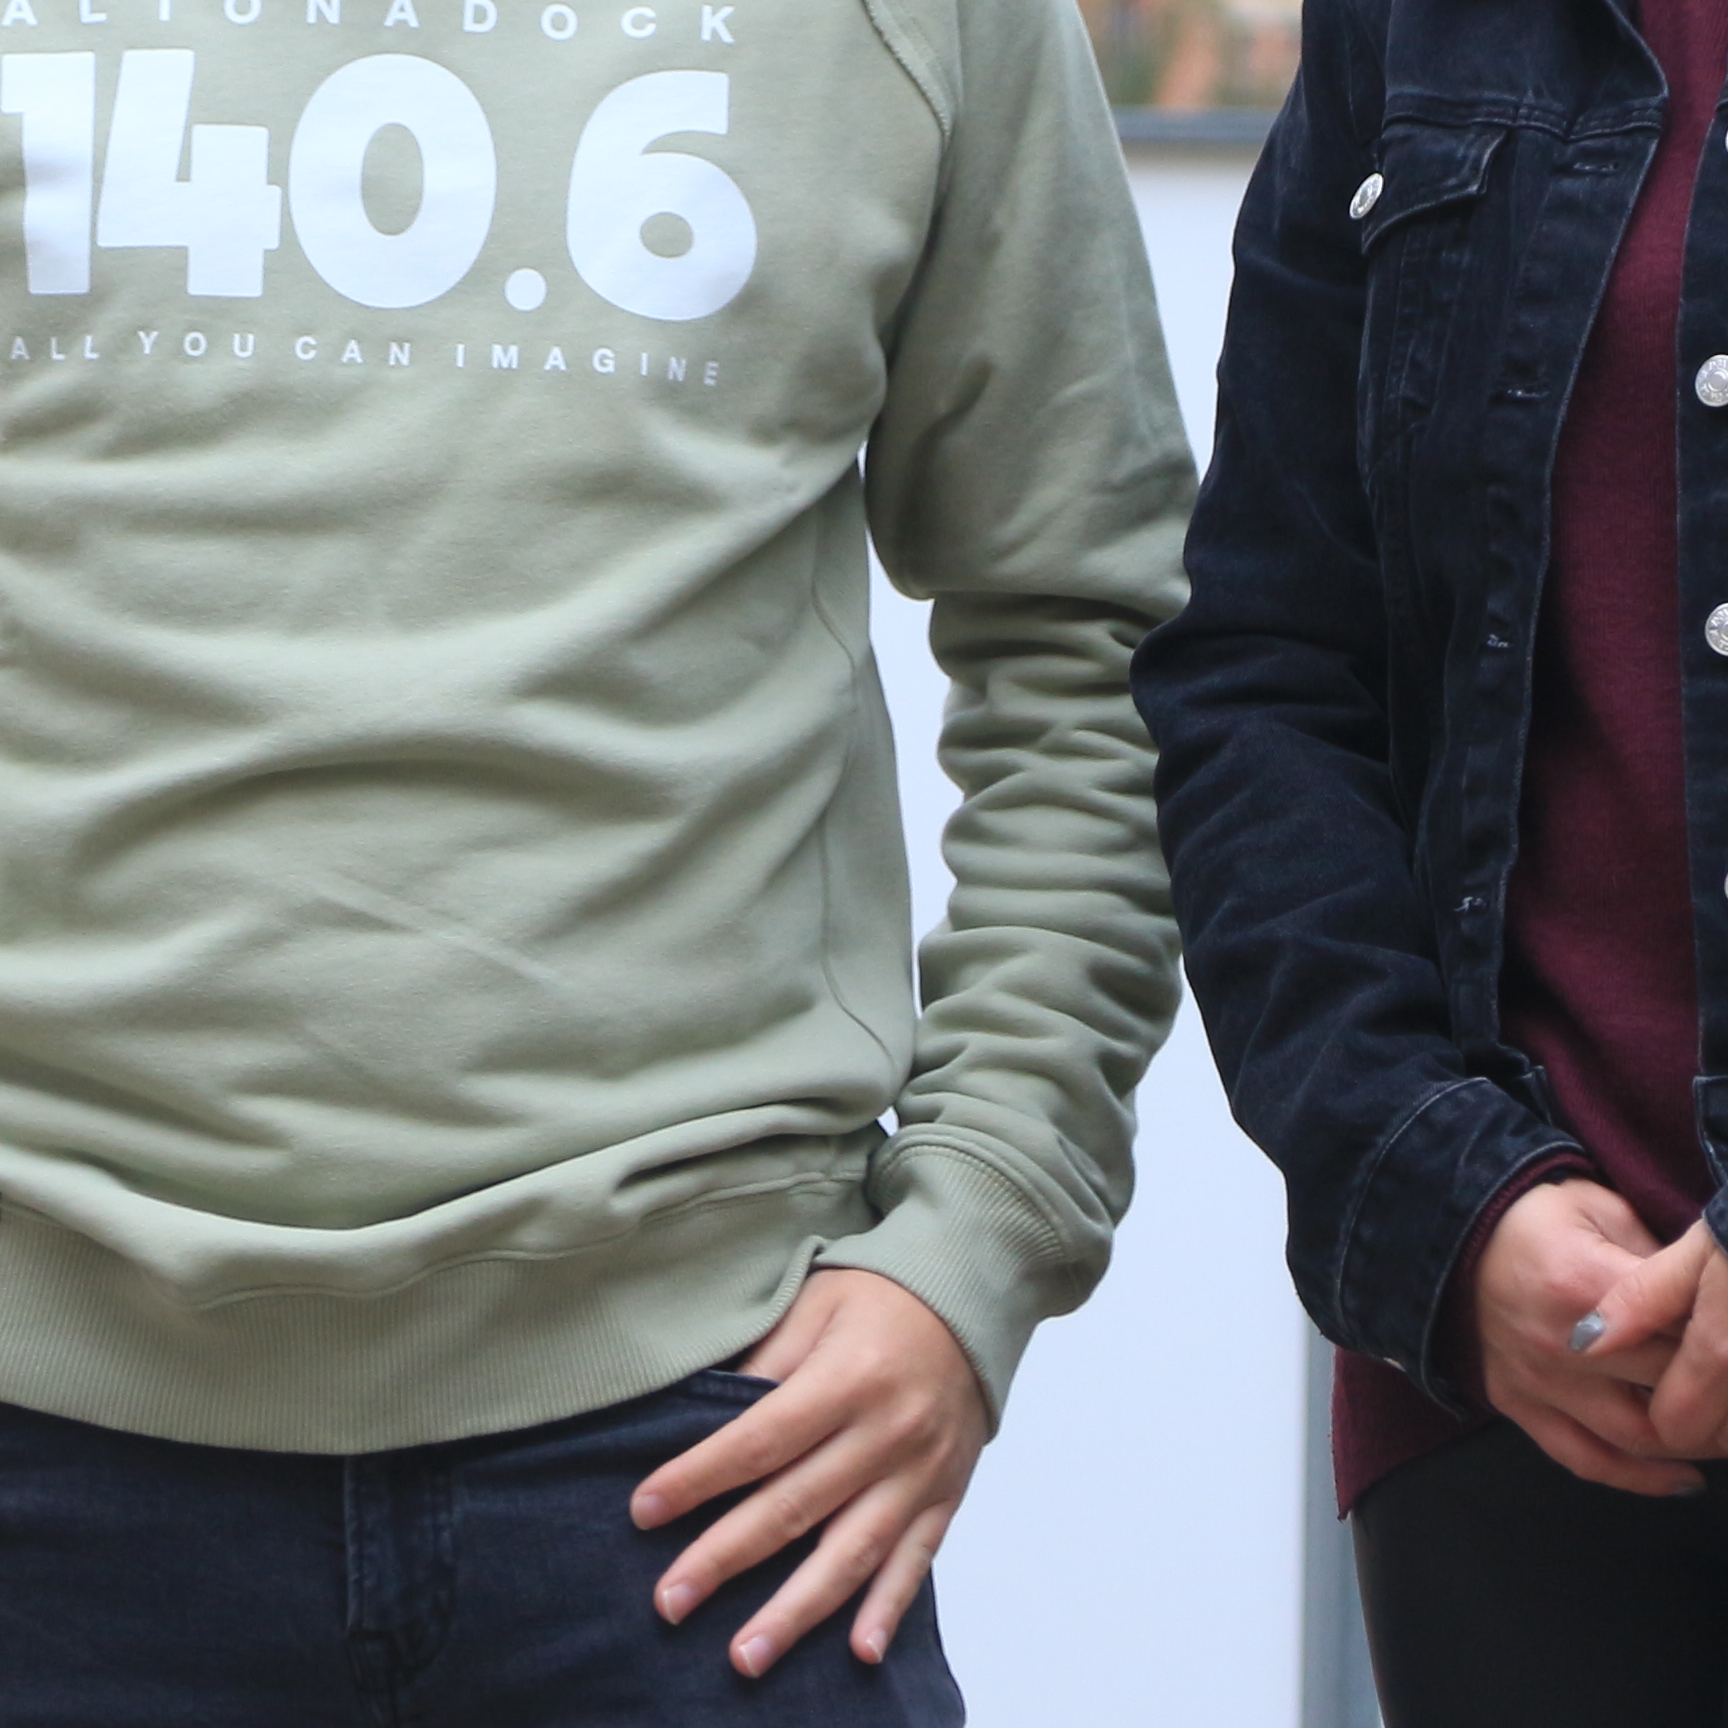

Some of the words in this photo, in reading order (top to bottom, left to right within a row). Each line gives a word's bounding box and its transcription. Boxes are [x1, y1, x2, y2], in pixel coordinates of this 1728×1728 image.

[9, 330, 101, 362] ALL
[136, 330, 256, 360] YOU
[294, 335, 412, 367] CAN
[455, 341, 721, 388] IMAGINE
